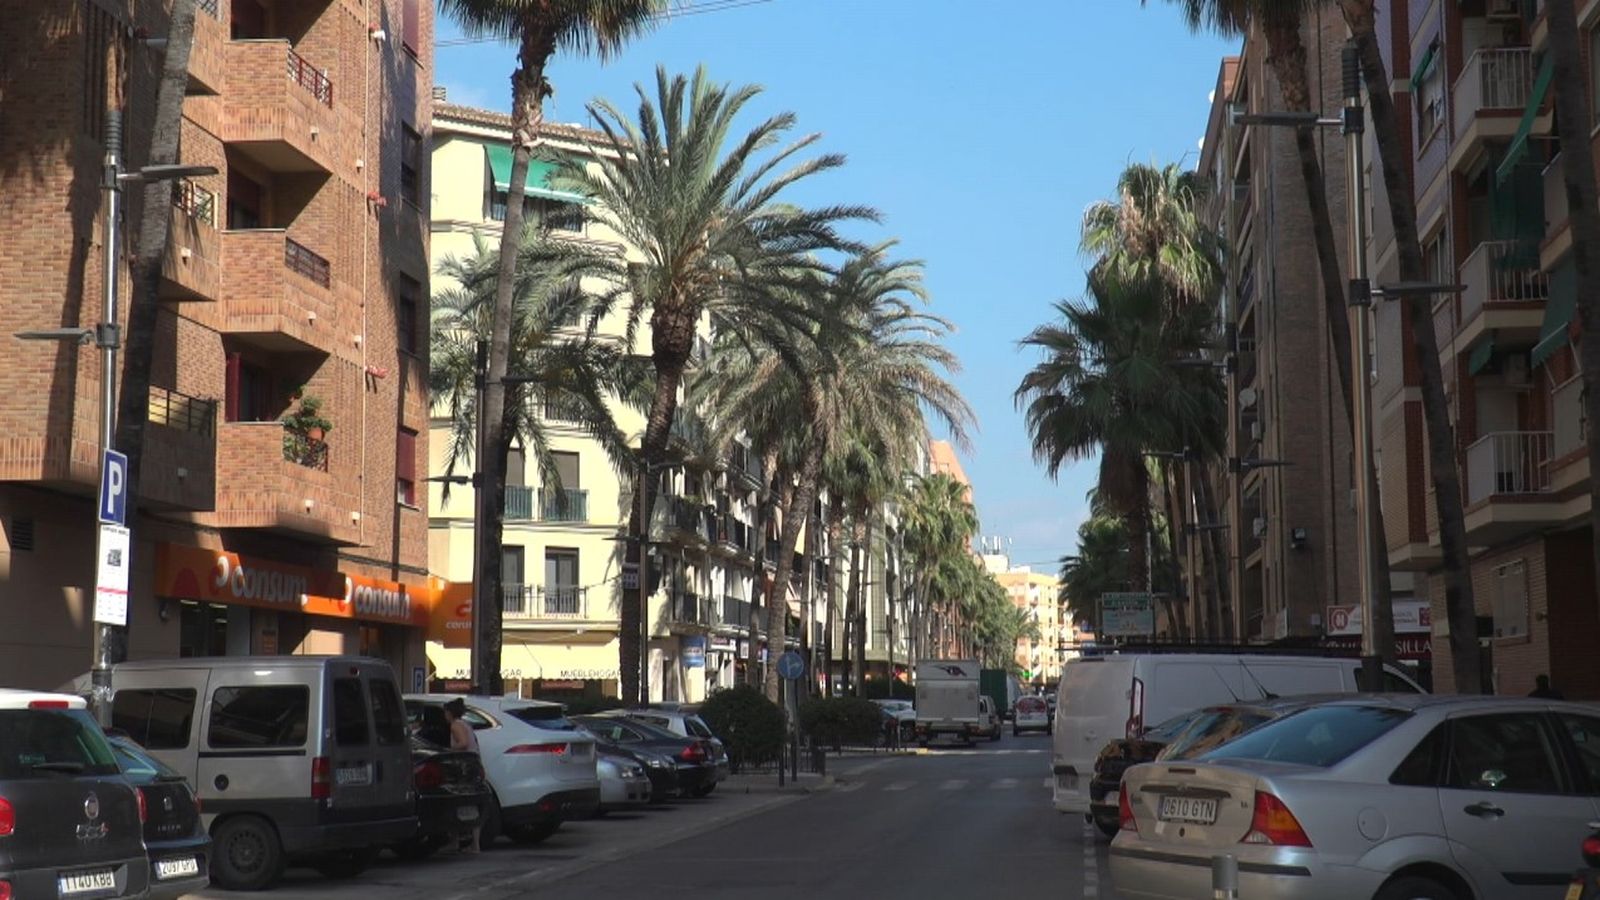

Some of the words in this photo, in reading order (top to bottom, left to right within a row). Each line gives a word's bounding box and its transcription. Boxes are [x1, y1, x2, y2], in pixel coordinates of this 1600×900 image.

[107, 460, 123, 514] P
[231, 565, 308, 606] consum
[355, 584, 410, 618] consum
[1164, 798, 1189, 816] 0610
[1191, 800, 1214, 818] GTN
[65, 874, 91, 891] 1140
